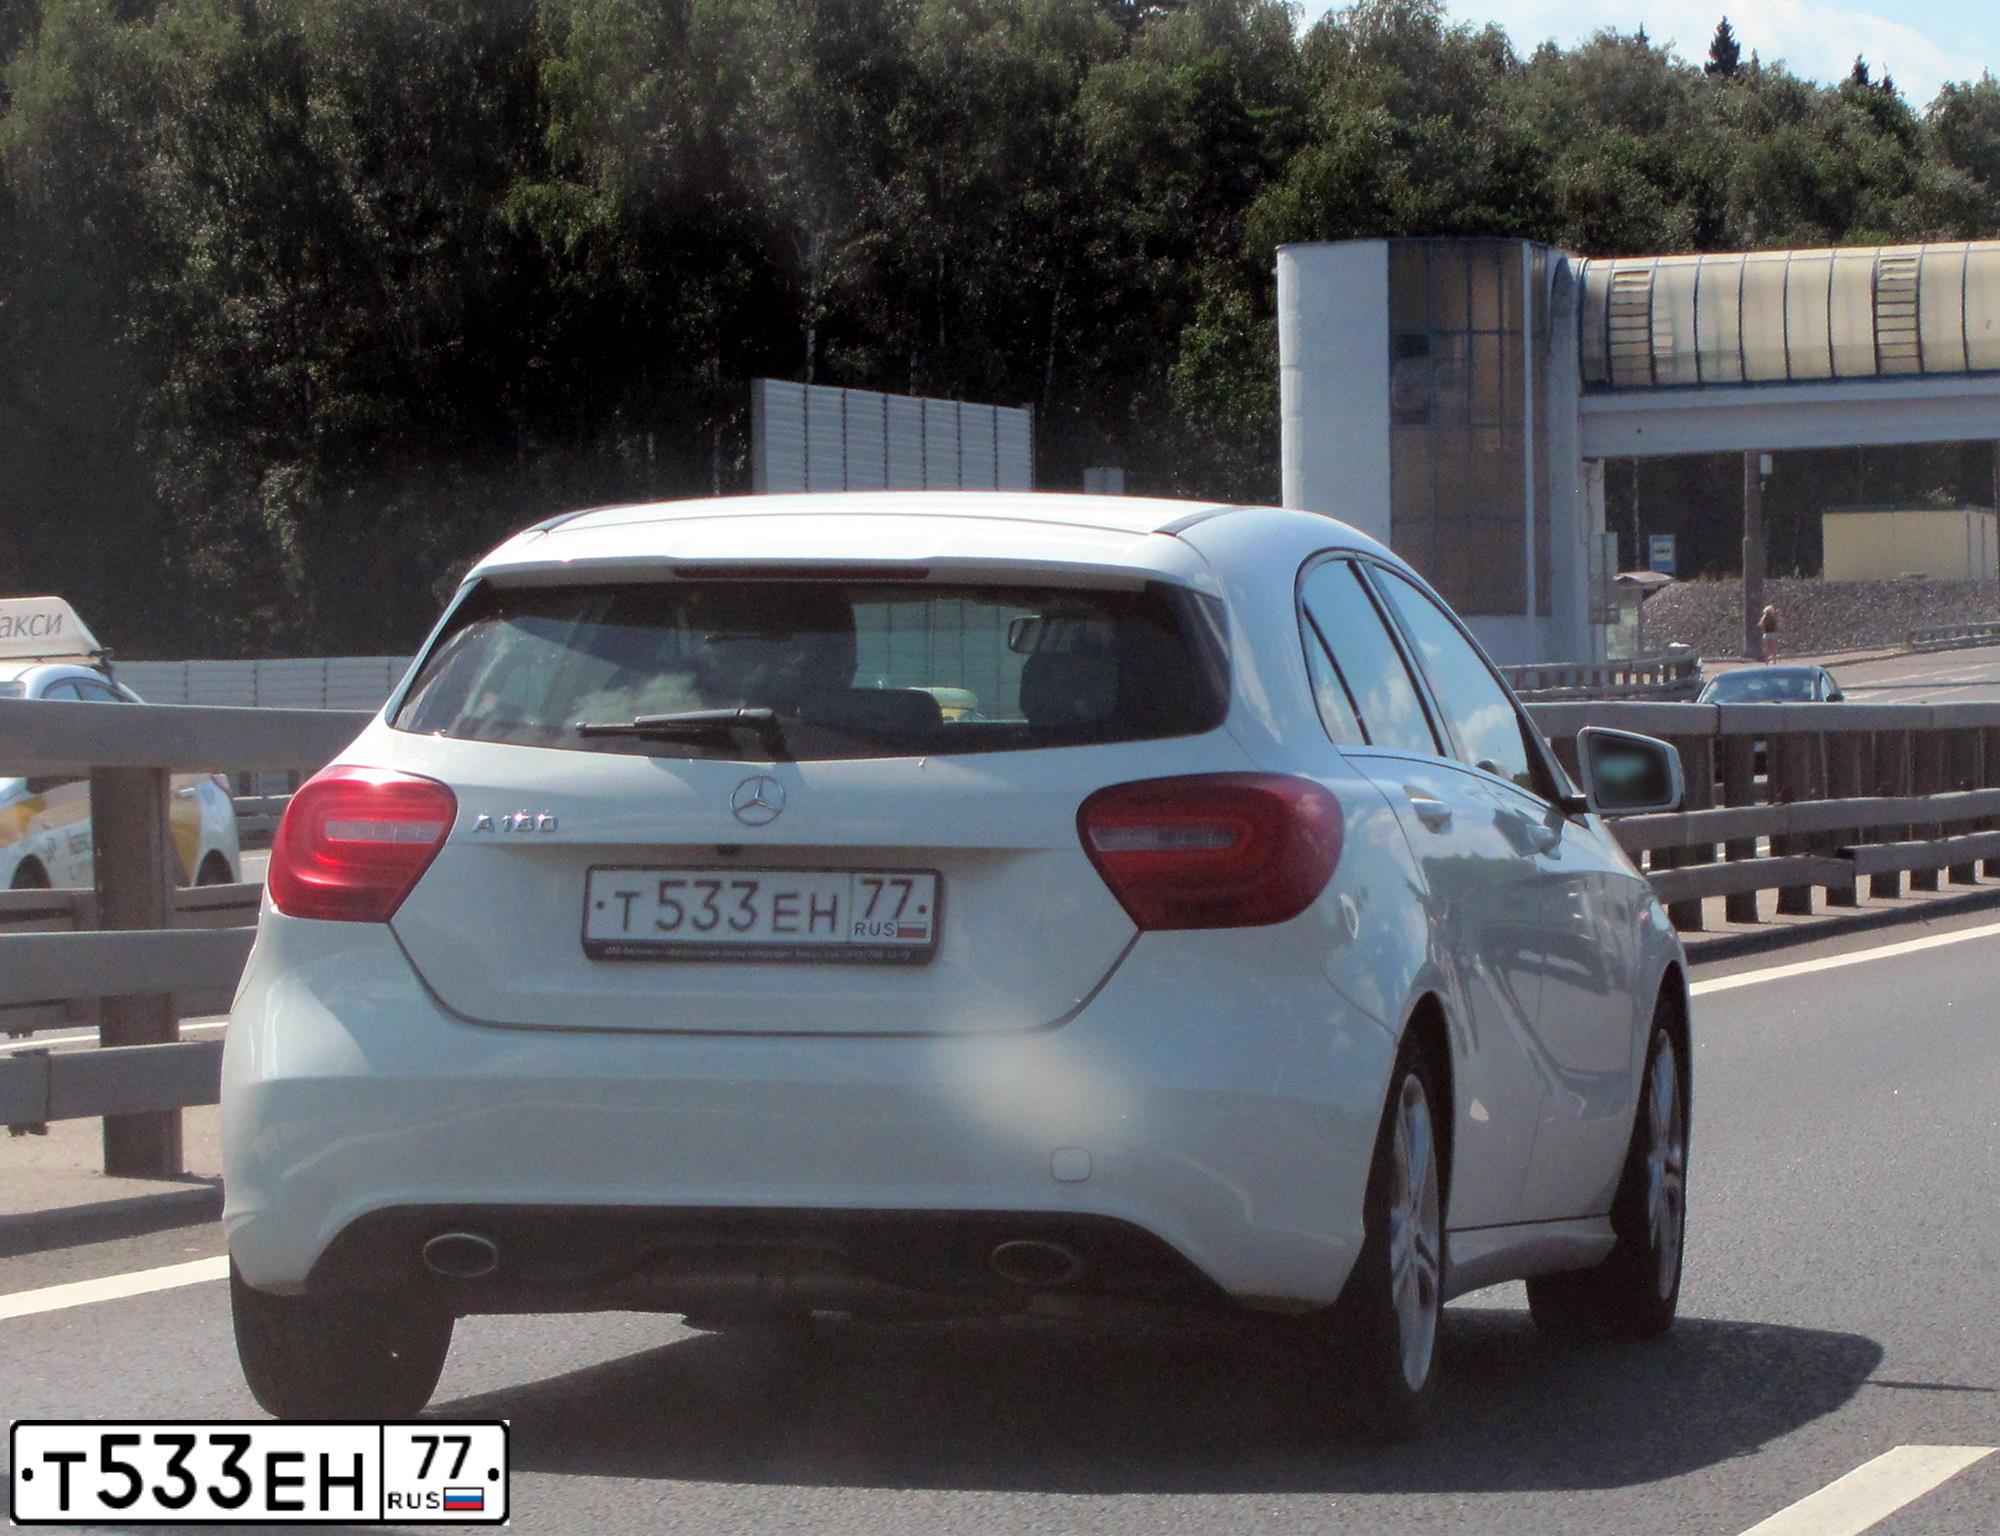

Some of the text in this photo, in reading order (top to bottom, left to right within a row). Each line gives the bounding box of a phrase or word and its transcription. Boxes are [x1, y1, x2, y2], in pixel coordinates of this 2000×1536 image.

[0, 607, 63, 638] акси
[859, 878, 914, 921] 77
[854, 921, 895, 937] RUS
